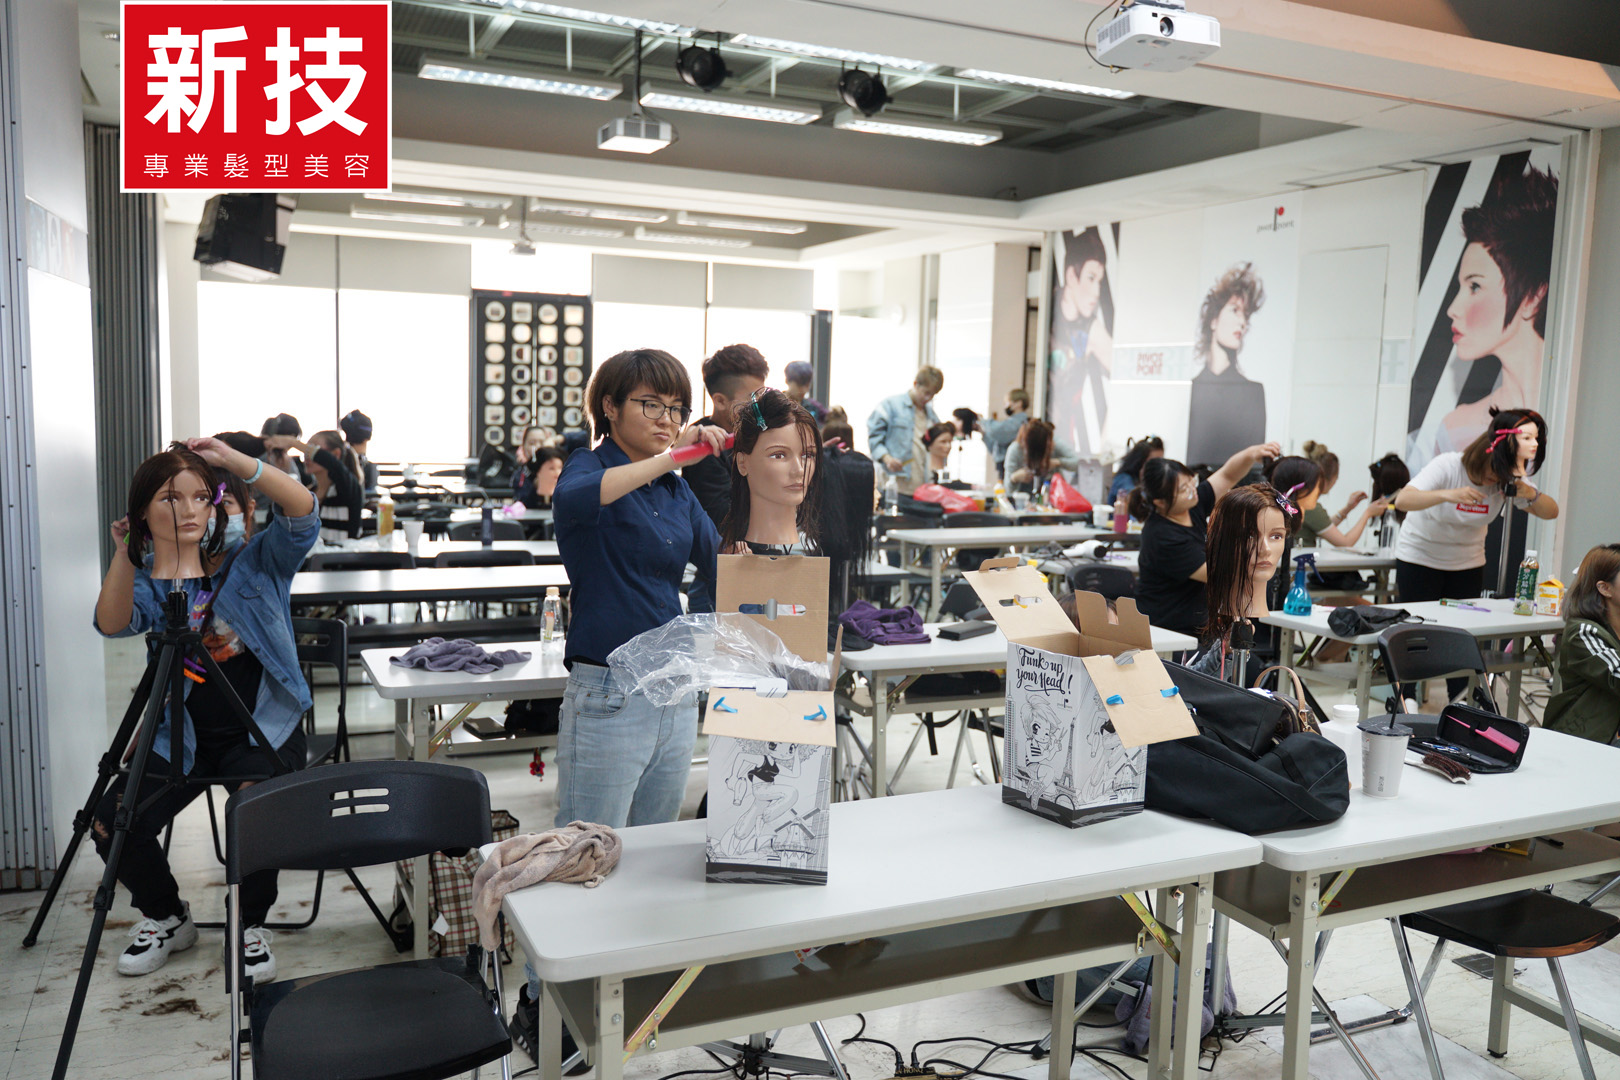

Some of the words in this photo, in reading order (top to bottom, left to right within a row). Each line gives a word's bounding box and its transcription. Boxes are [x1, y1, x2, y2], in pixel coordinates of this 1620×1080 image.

[1018, 647, 1050, 671] Funk
[1050, 661, 1063, 678] up
[1016, 668, 1039, 689] your
